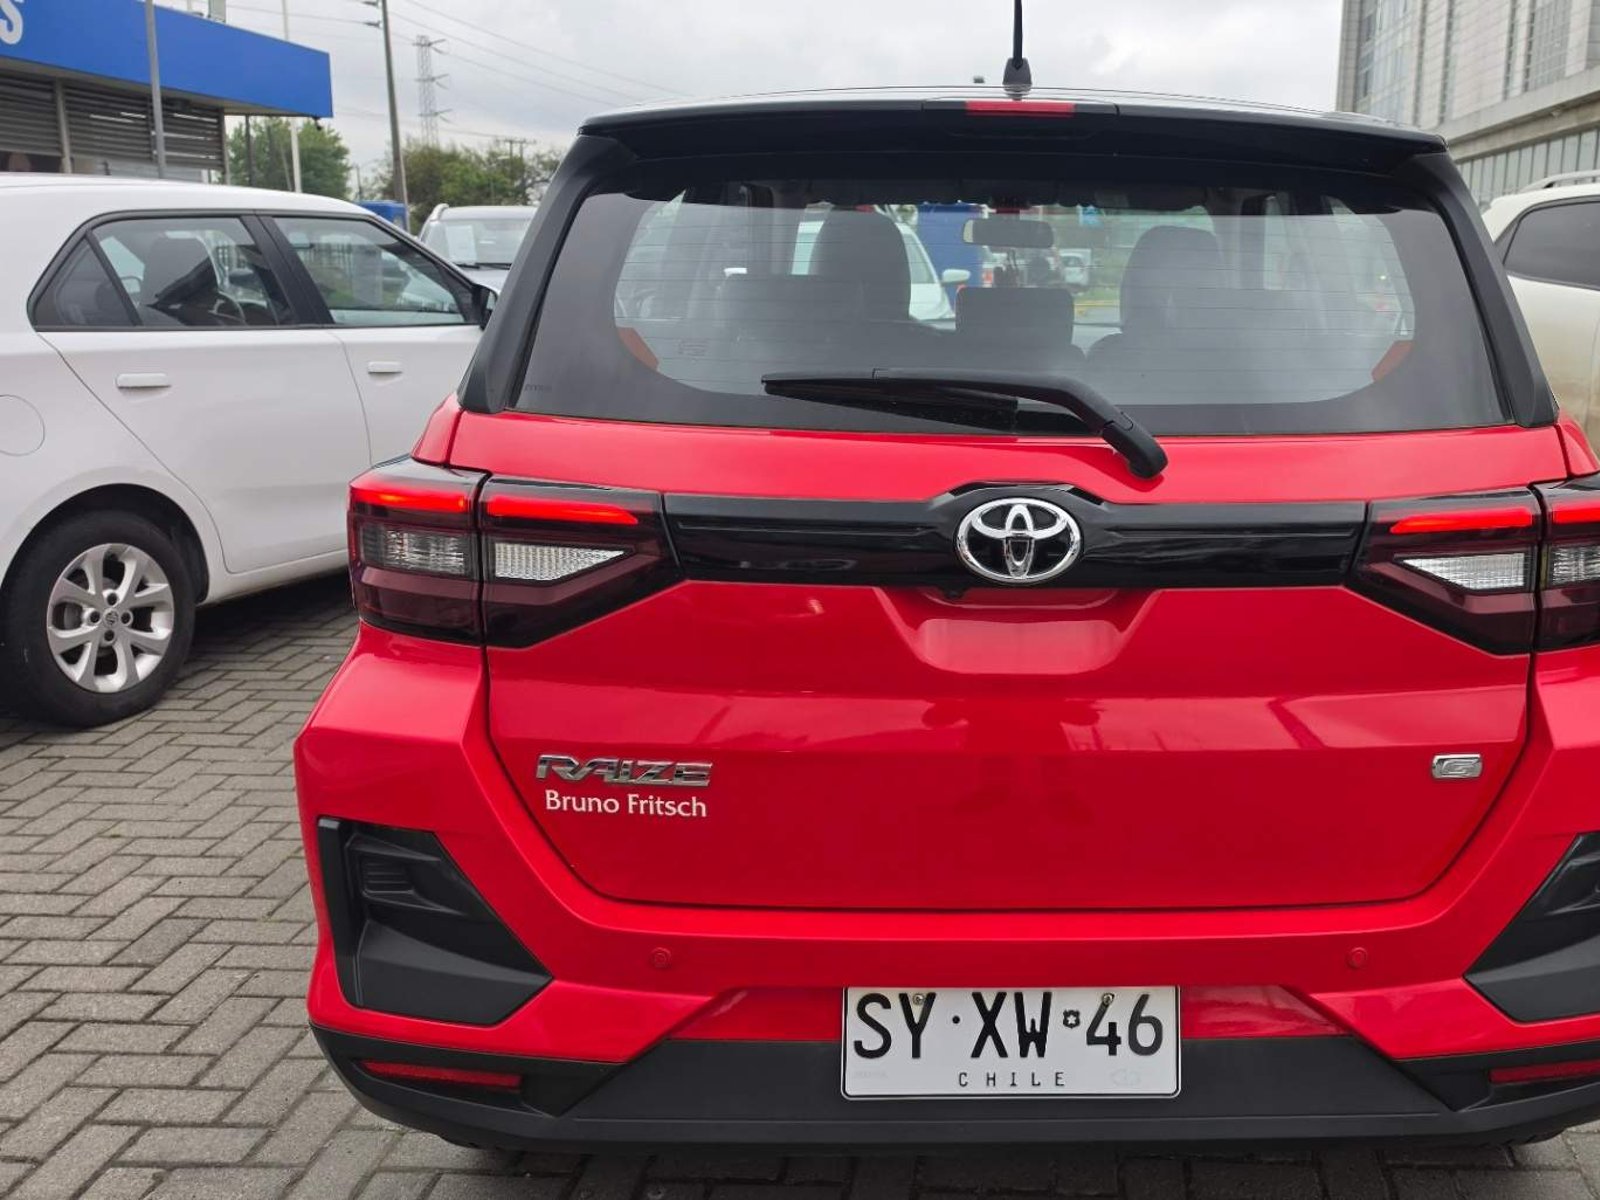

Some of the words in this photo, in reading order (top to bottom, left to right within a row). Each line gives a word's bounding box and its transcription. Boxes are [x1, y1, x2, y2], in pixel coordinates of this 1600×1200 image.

[536, 754, 713, 787] RAIZE
[545, 789, 620, 814] Bruno
[627, 793, 707, 818] Fritsch
[1086, 993, 1164, 1056] 46
[958, 1072, 1066, 1087] CHILE
